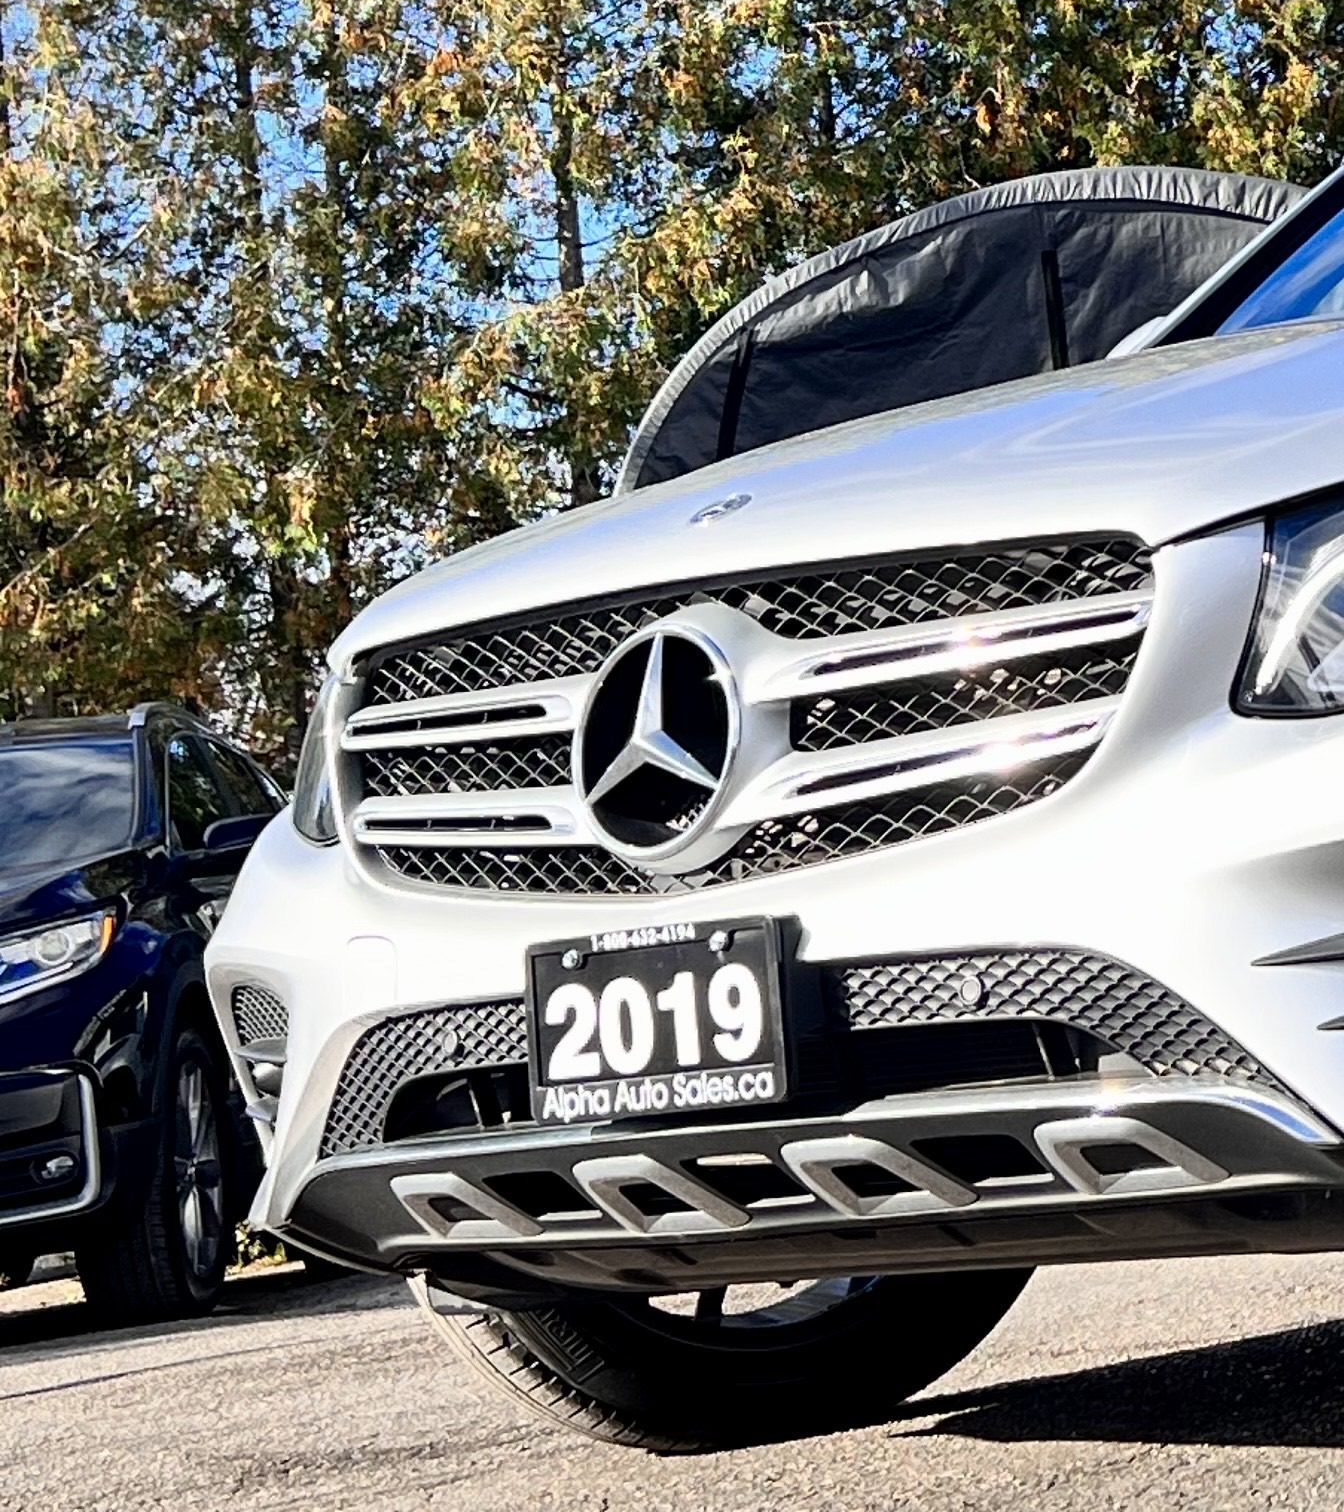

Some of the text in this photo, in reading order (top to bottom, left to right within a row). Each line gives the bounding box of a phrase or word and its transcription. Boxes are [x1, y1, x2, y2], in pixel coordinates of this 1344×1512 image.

[544, 962, 763, 1081] 2019
[542, 1070, 775, 1123] Alpha Auto Sales.ca
